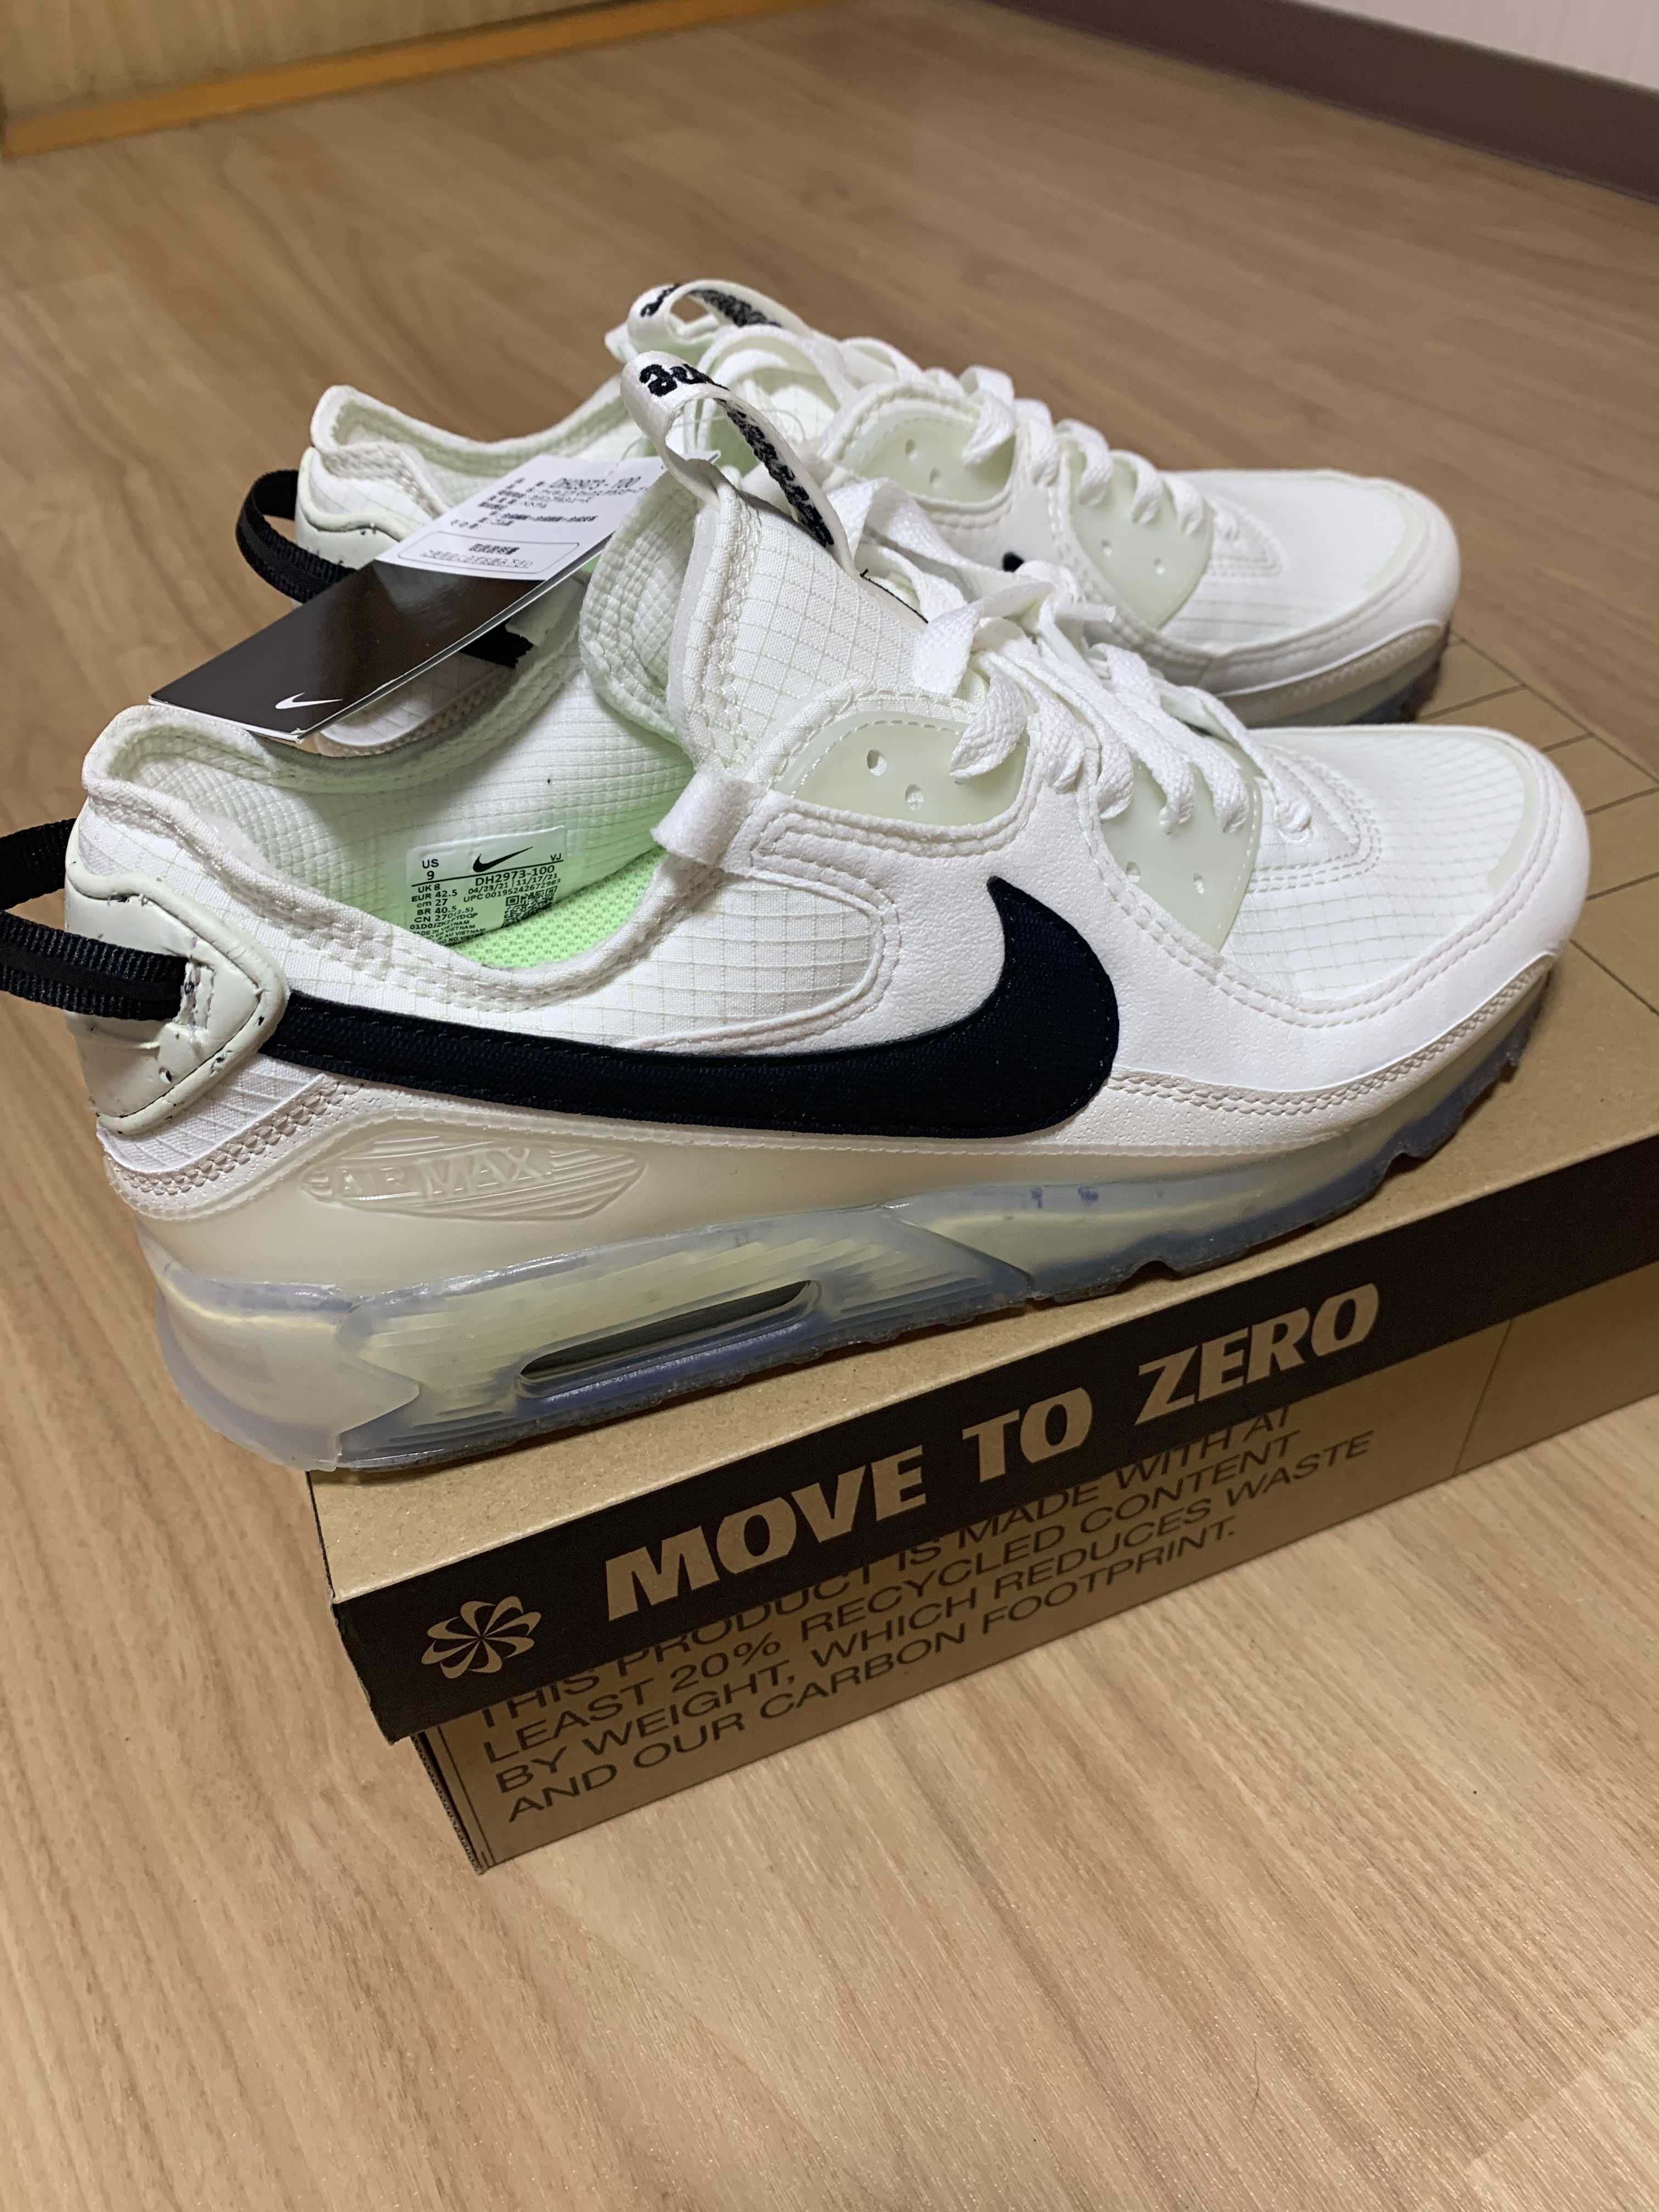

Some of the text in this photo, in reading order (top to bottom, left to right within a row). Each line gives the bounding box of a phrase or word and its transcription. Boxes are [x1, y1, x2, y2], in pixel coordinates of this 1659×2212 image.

[550, 853, 562, 861] VJ
[422, 859, 439, 869] US
[426, 870, 435, 881] 9
[475, 865, 555, 887] DH2973-100
[418, 883, 441, 894] UK 8
[468, 882, 509, 895] 04/23/21
[516, 873, 558, 886] 11/17/21
[411, 889, 458, 902] EUR 42.5
[463, 893, 484, 903] UPC
[435, 898, 448, 907] 27
[435, 905, 457, 915] 40.5
[445, 924, 476, 934] VIETNAM
[420, 1147, 543, 1200] MAX
[605, 1283, 1379, 1622] MOVE TO ZERO
[958, 1483, 1100, 1549] MADE
[1114, 1426, 1232, 1489] WITH
[483, 1429, 1301, 1764] LEAST 20% RECYCLED CONTENT
[495, 1429, 1375, 1793] BY WEIGHT, WHICH REDUCES WASTE
[508, 1515, 1237, 1822] AND OUR CARBON FOOTPRINT.
